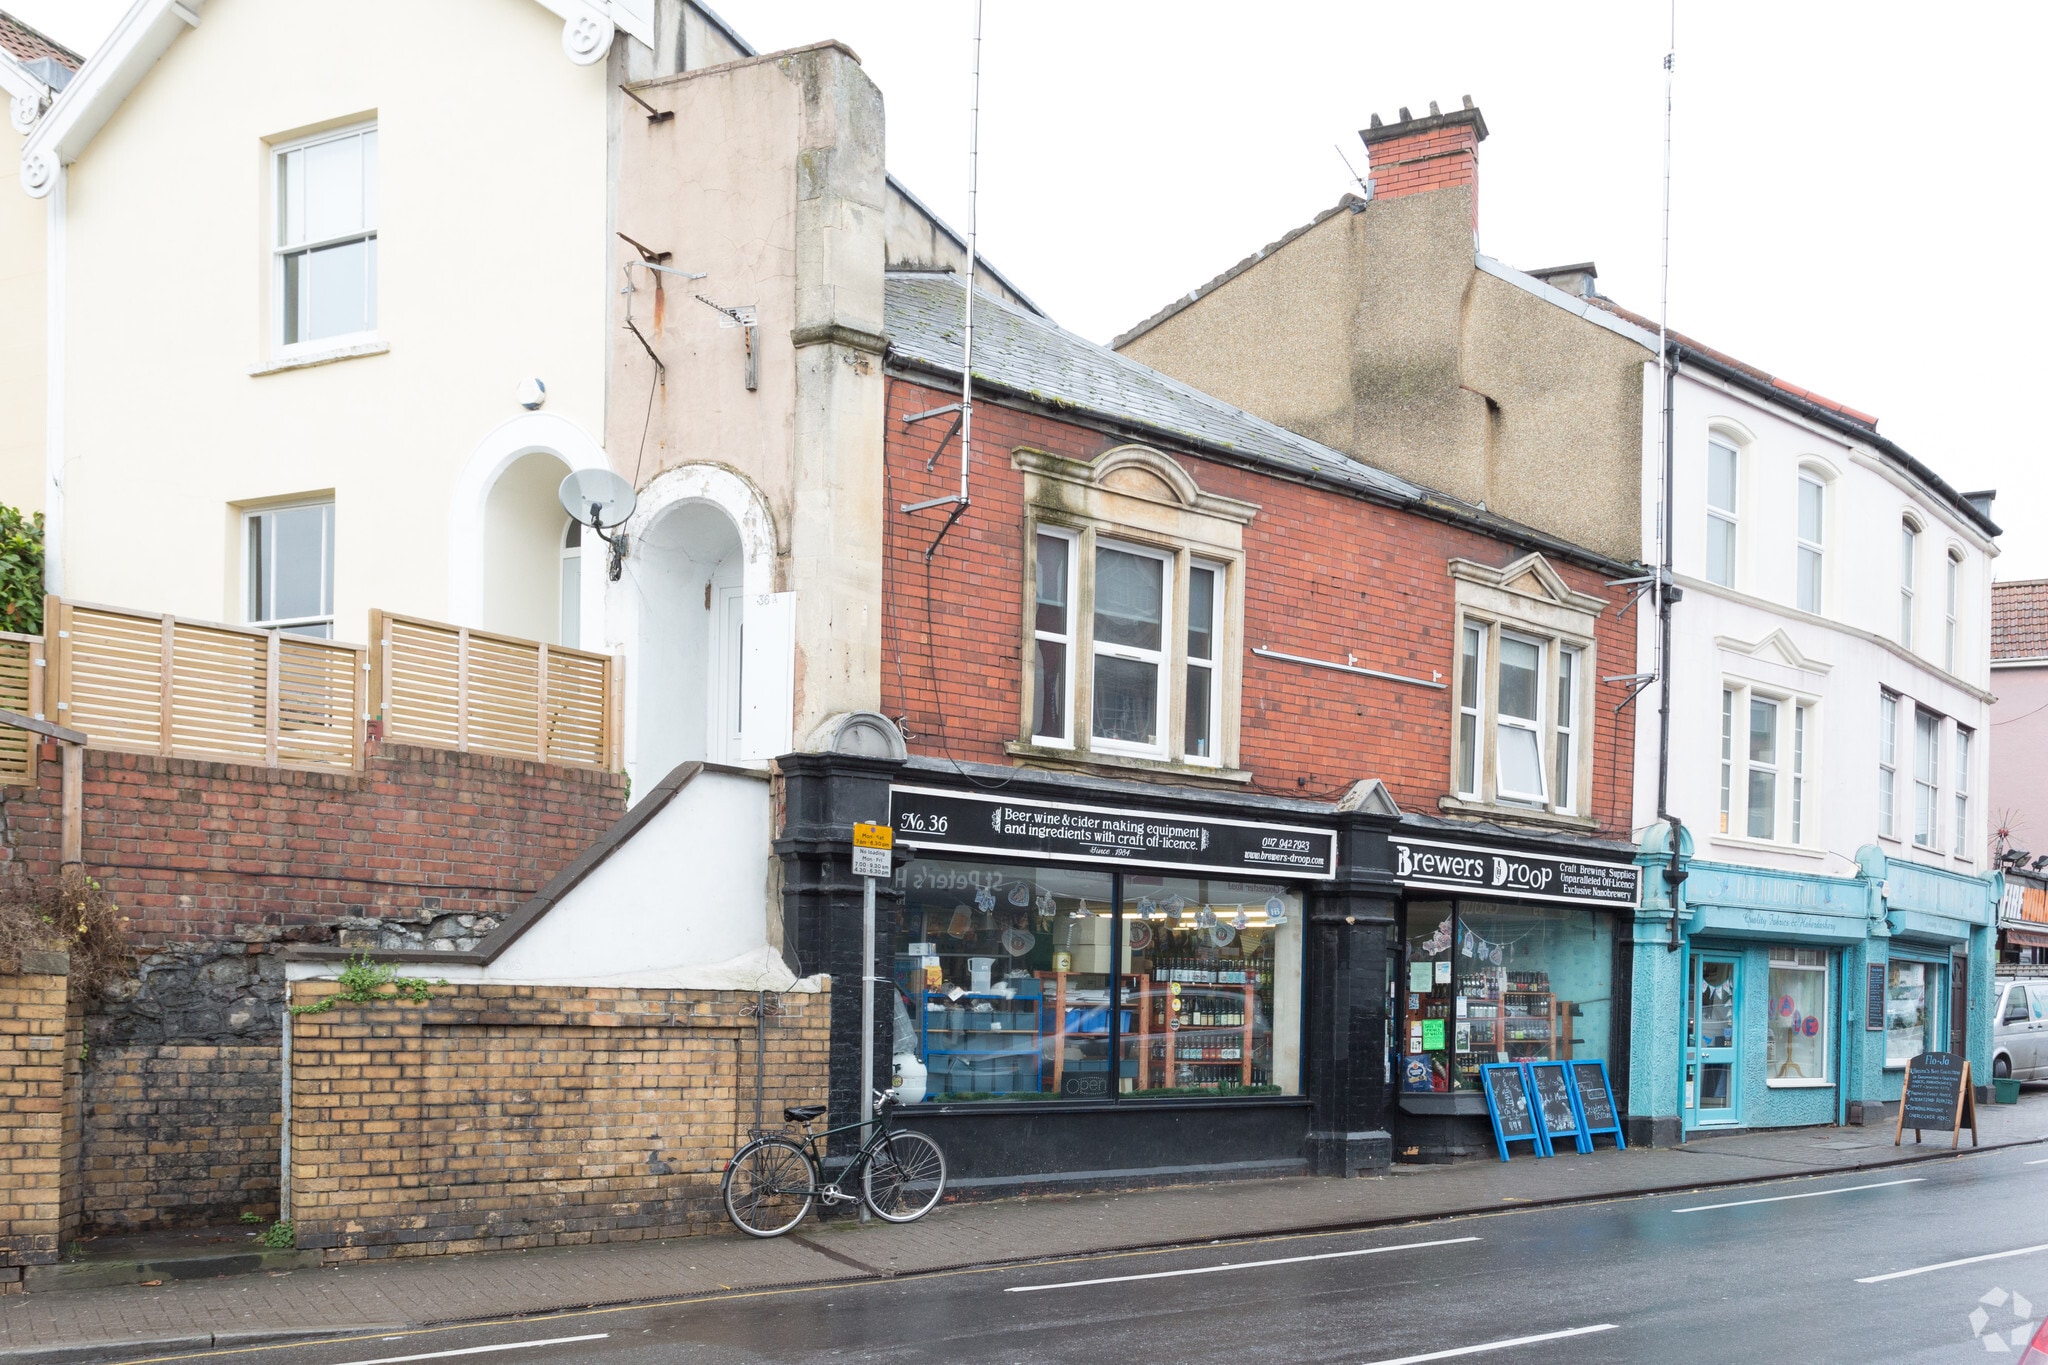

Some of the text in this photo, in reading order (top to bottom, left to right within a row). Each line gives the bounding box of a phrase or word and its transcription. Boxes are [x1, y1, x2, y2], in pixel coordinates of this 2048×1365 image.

[756, 594, 770, 606] 36
[900, 812, 949, 833] No. 36
[1071, 815, 1101, 829] cider
[1102, 819, 1145, 838] making
[1146, 824, 1199, 843] equipment
[1004, 823, 1027, 836] and
[1028, 824, 1092, 842] ingredients
[1094, 830, 1117, 844] with
[1117, 834, 1144, 847] craft
[1089, 845, 1111, 855] Since
[1293, 839, 1310, 851] 7923
[1244, 850, 1325, 866] www.brewers-droop.com
[1396, 845, 1552, 890] Brewers Droop
[1559, 862, 1636, 880] Craft Brewing Supplies
[1560, 872, 1635, 890] Unparalleled Off-Licence
[1563, 883, 1632, 902] Exclusive Nanobrewery
[1743, 911, 1767, 929] Quality
[1768, 913, 1790, 927] Fabrics
[1798, 916, 1836, 934] Haberdashery
[1925, 1055, 1950, 1066] Flo-Jo
[1065, 1077, 1107, 1095] Open
